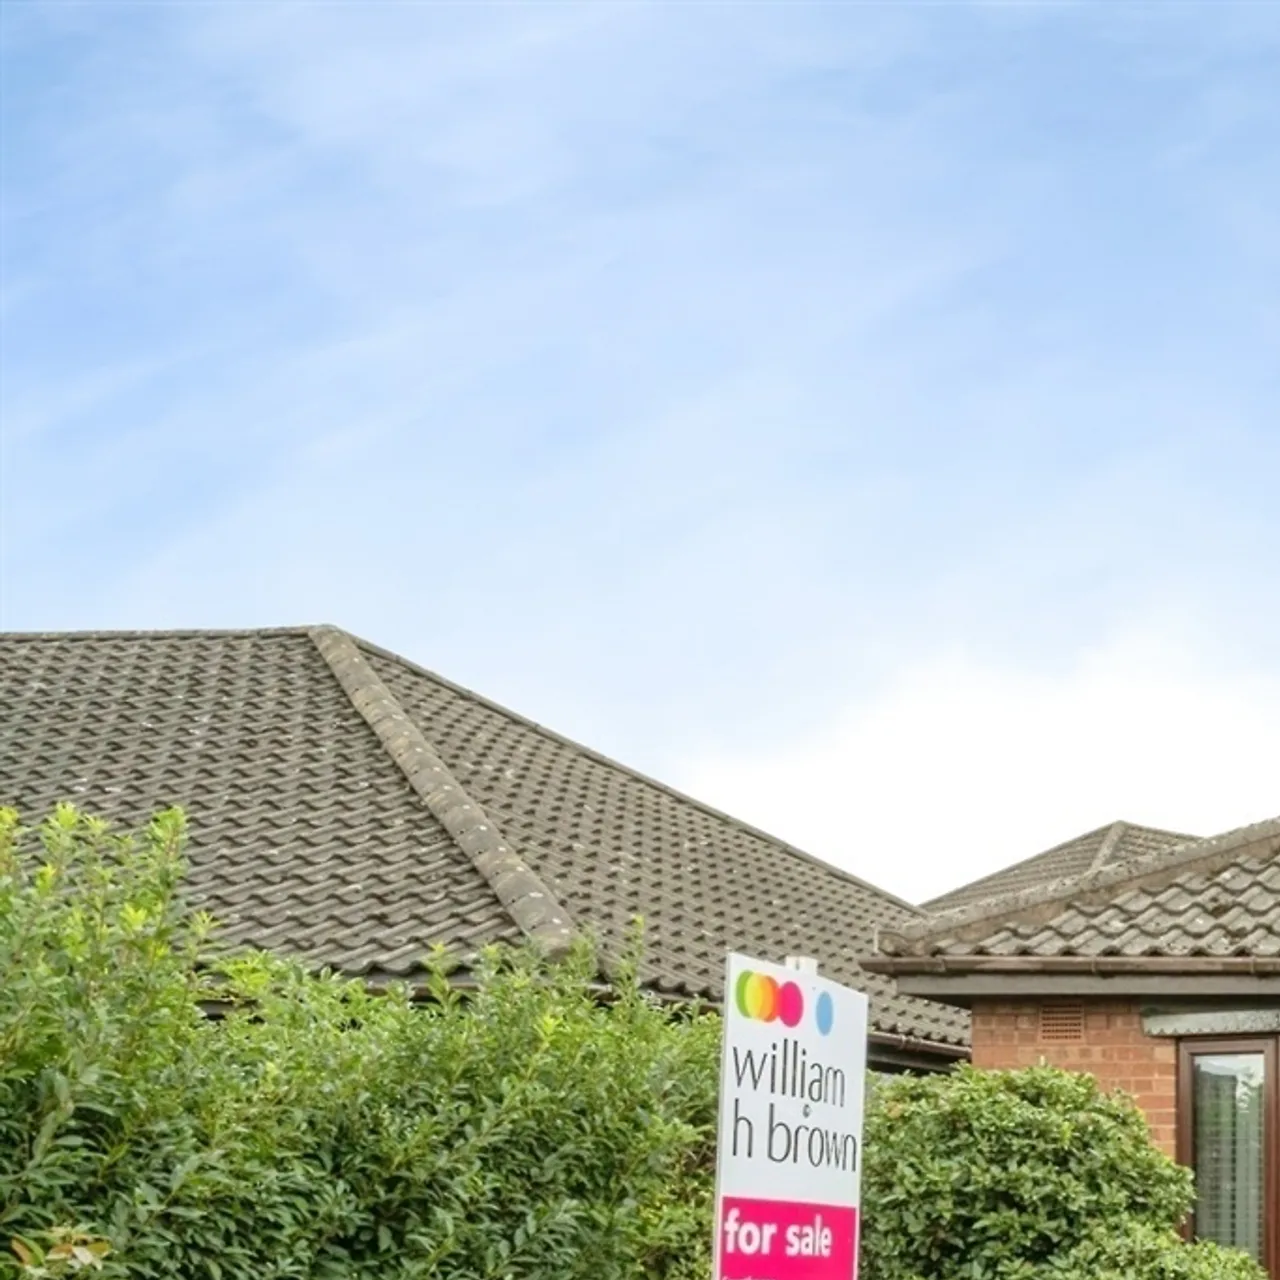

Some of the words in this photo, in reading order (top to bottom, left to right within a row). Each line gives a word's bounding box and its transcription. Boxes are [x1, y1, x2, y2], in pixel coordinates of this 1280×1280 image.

[732, 1037, 845, 1108] william
[732, 1097, 753, 1158] h
[767, 1102, 857, 1172] brown
[724, 1207, 778, 1255] for
[785, 1213, 832, 1258] sale
